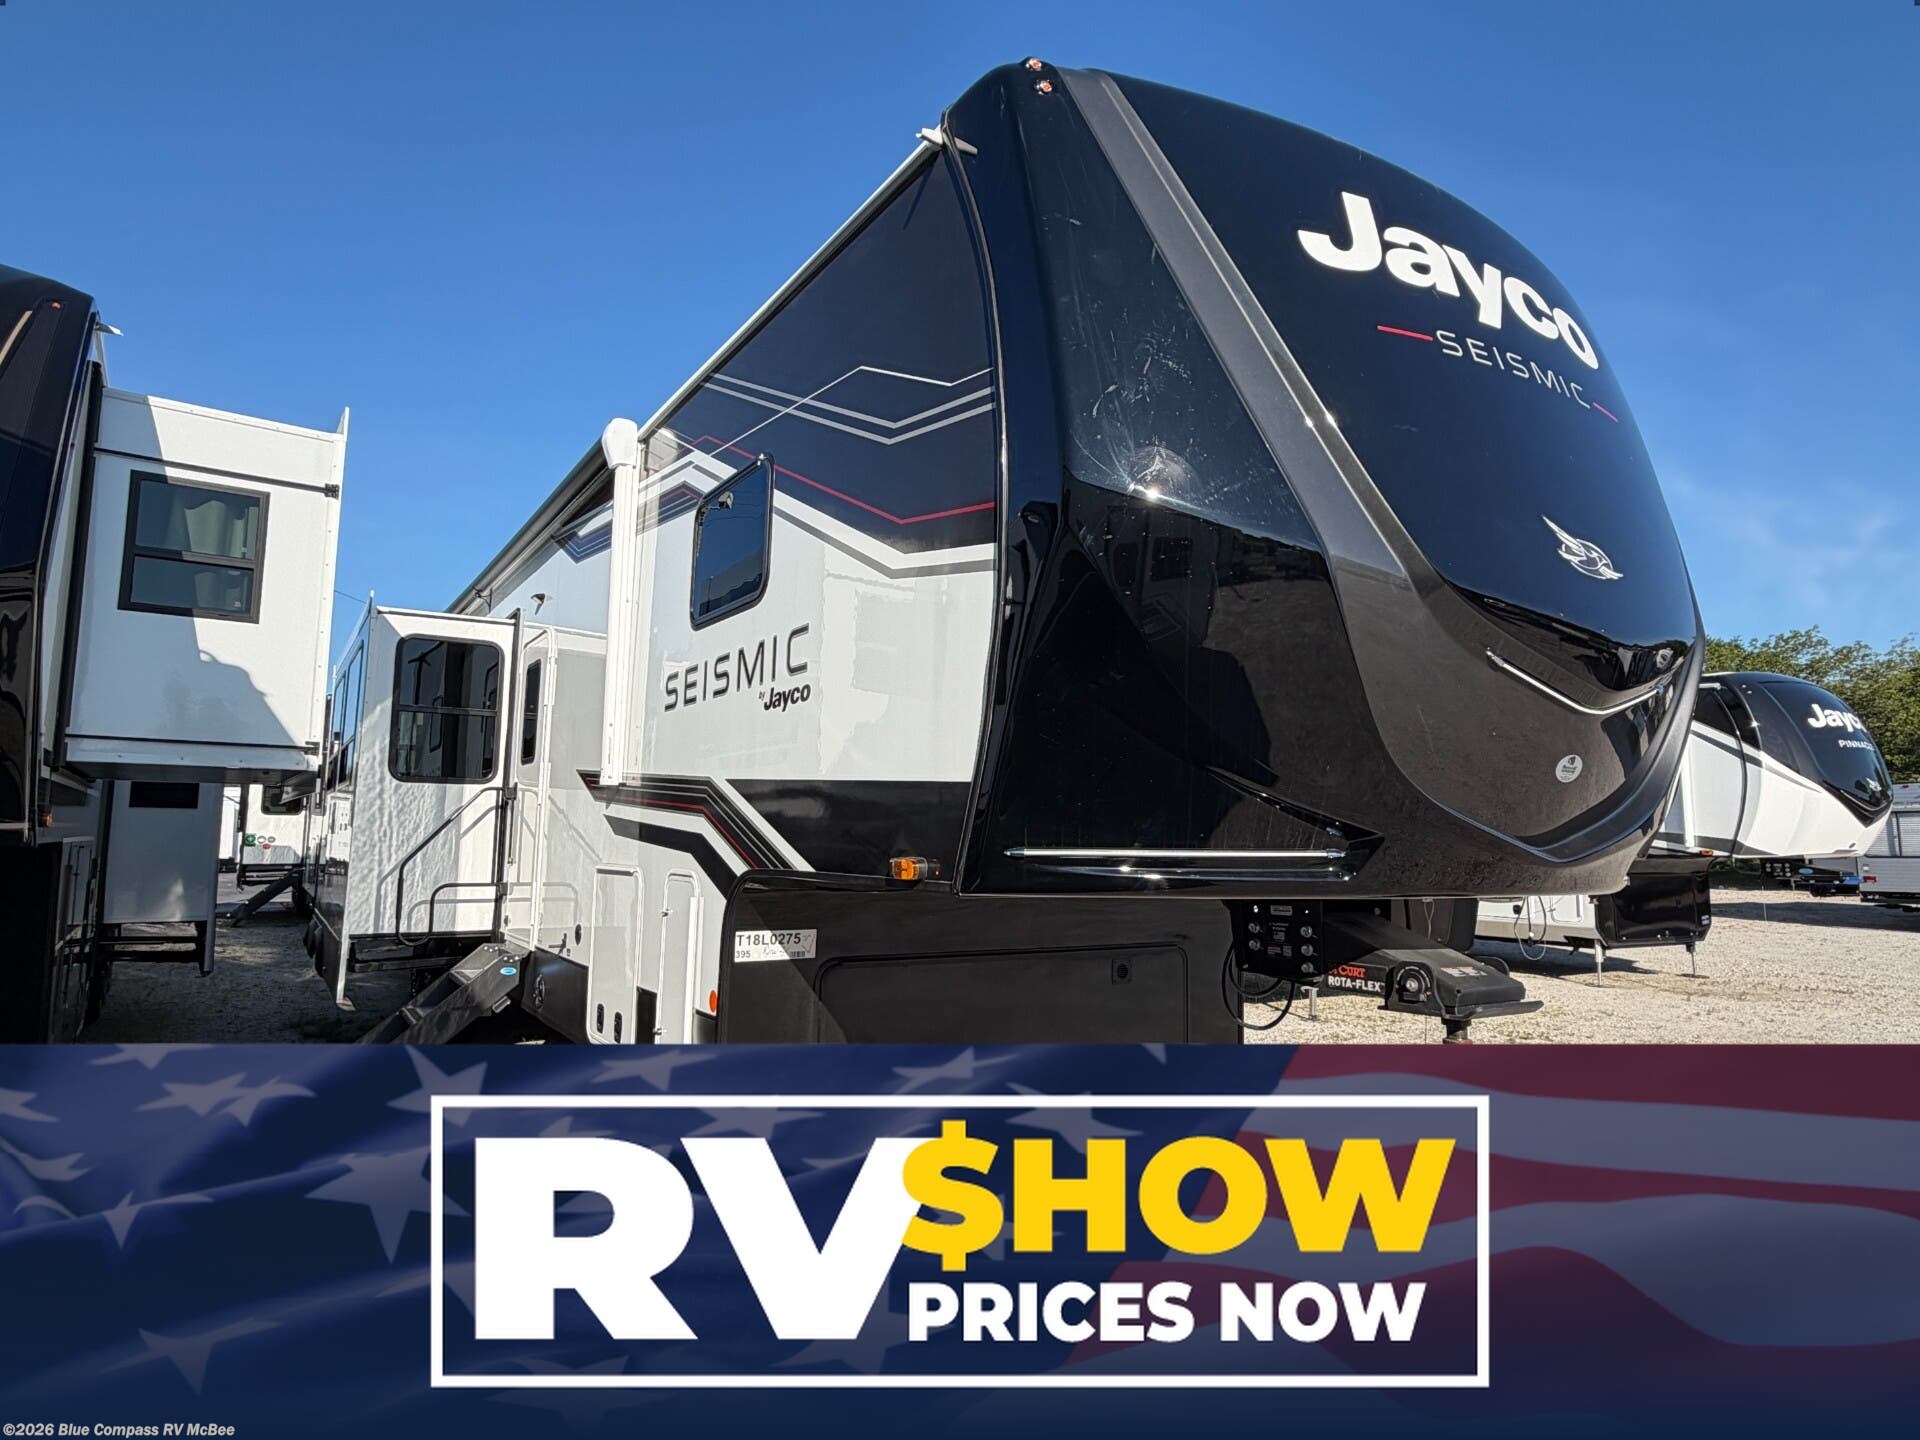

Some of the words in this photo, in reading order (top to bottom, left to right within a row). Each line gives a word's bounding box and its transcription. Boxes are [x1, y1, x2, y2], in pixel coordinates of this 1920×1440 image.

[1297, 191, 1599, 370] Jayco
[1435, 330, 1591, 409] SEISMIC
[664, 623, 809, 712] SEISMIC
[764, 684, 811, 712] Jayco
[736, 932, 801, 946] T18L0275
[1328, 976, 1381, 993] ROTA-FLEX
[1338, 965, 1366, 979] CURT
